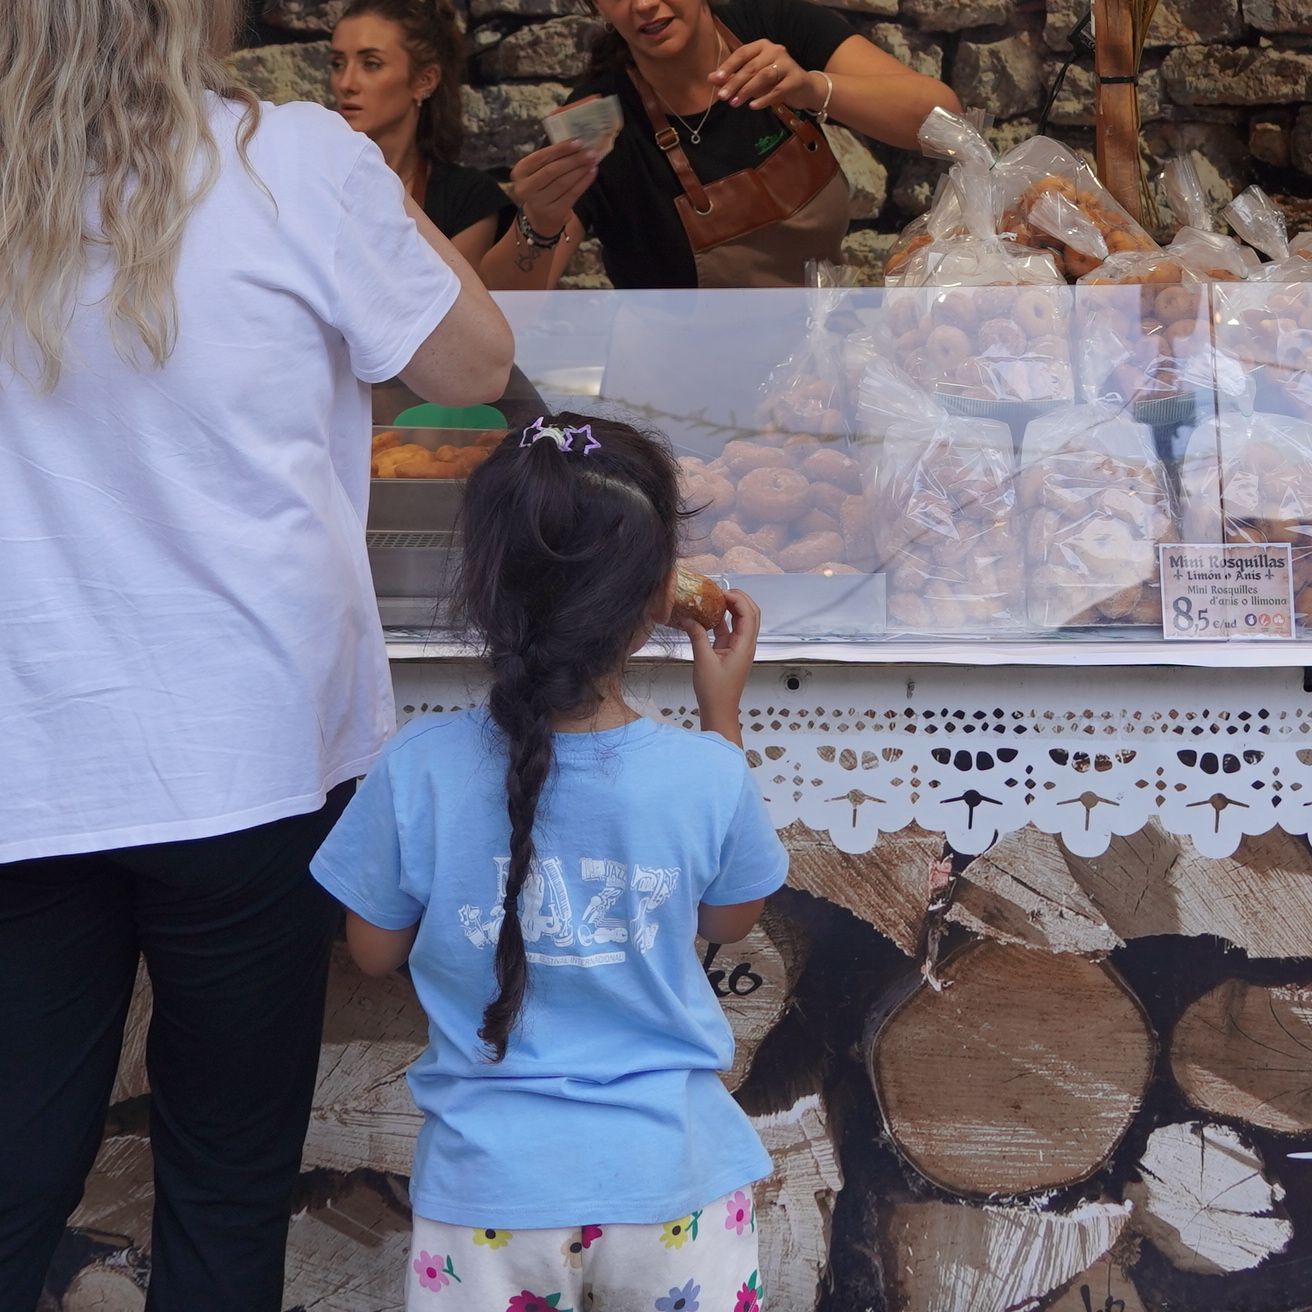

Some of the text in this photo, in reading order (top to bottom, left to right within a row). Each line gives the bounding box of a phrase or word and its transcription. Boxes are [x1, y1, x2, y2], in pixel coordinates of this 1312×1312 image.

[1169, 554, 1285, 572] Mini Rosquillas
[1187, 570, 1221, 580] Limón
[1188, 585, 1258, 596] Mini Rosquilles
[1251, 596, 1287, 605] llimona
[1172, 596, 1210, 632] 8,5
